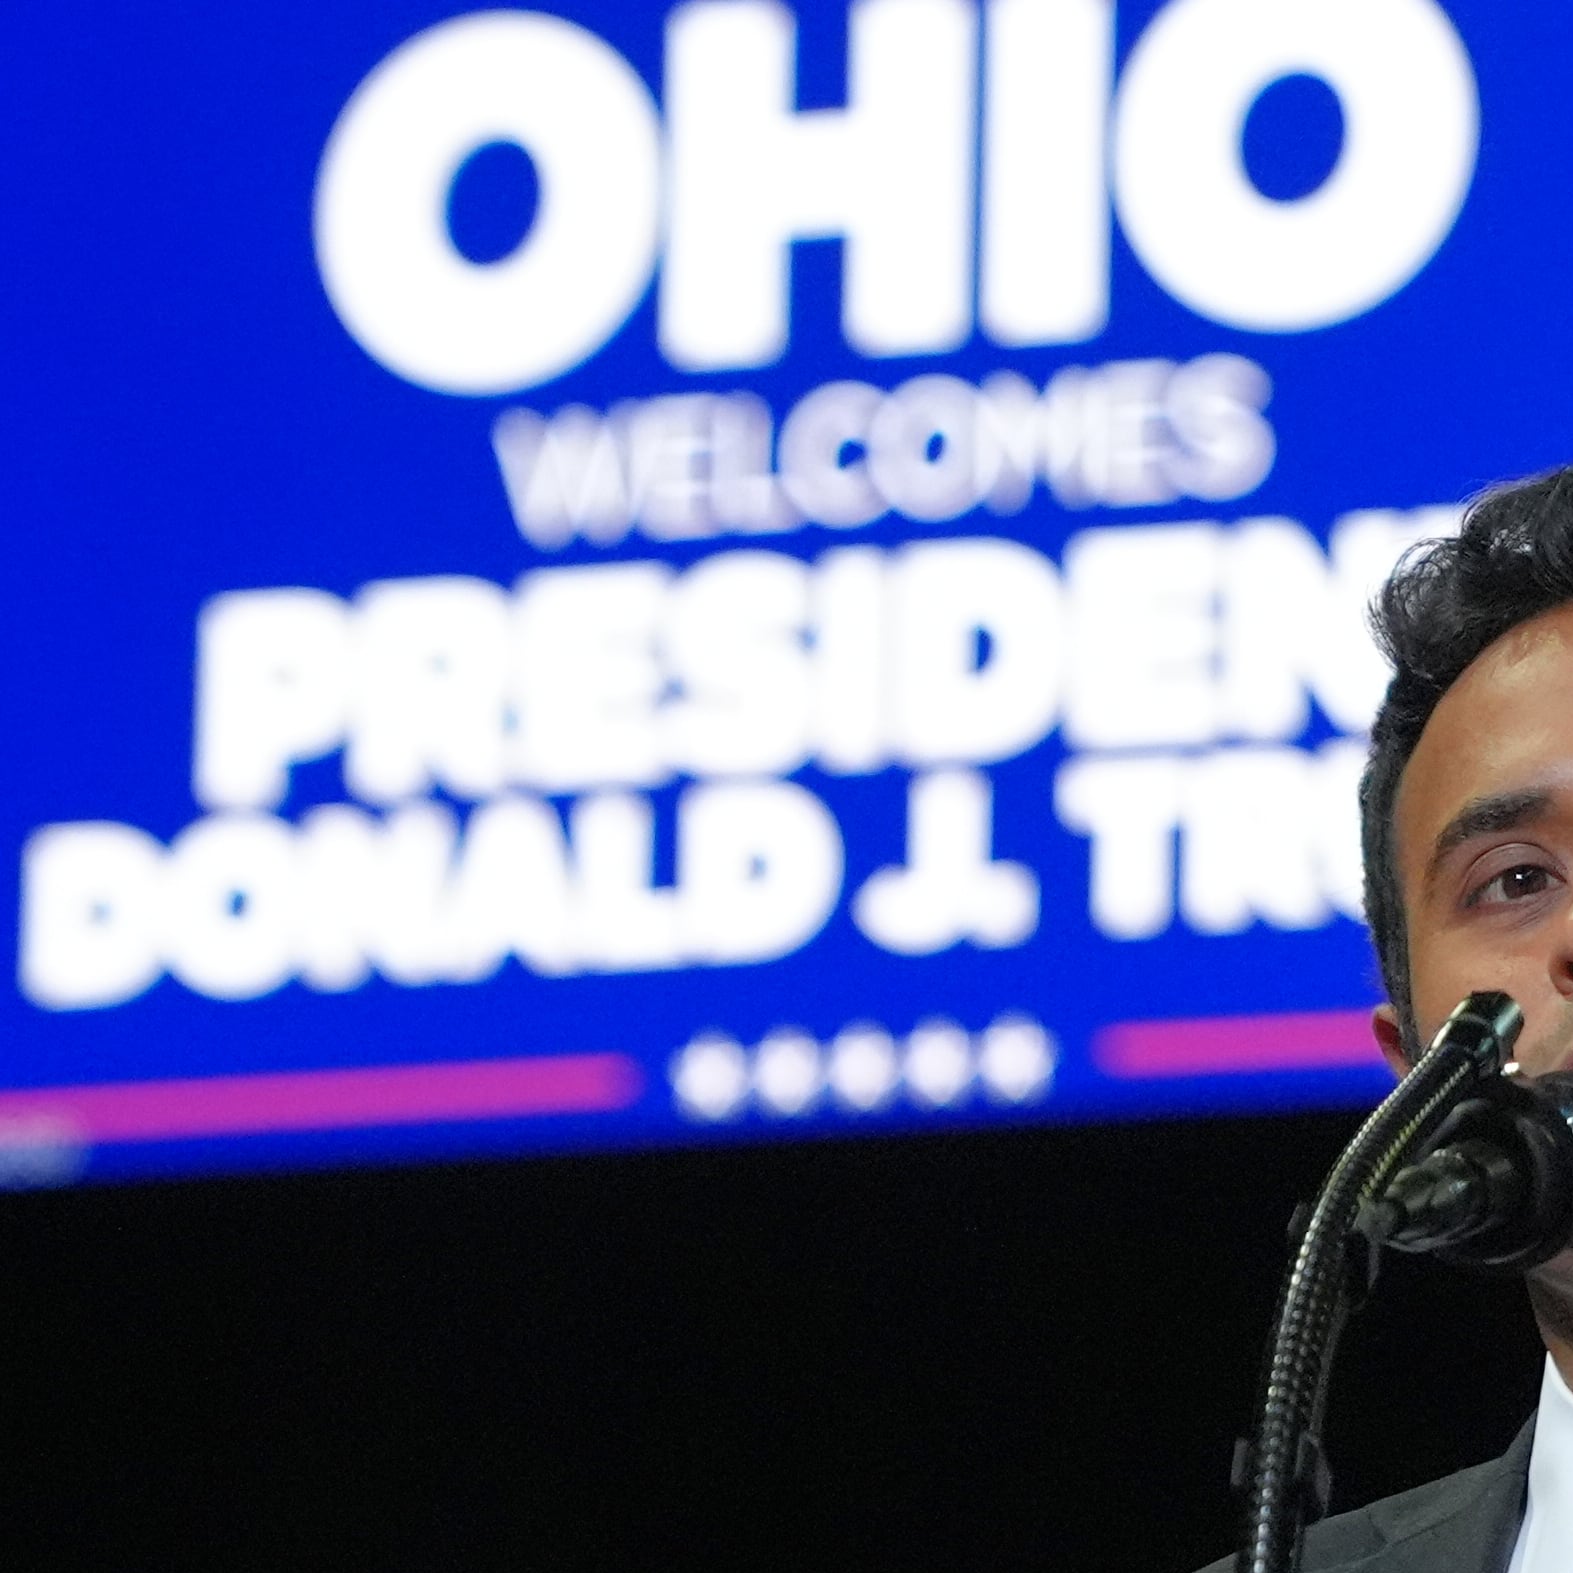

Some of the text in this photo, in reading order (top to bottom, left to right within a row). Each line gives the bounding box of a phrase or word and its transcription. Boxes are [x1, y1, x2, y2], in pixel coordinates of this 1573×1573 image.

[312, 0, 1482, 397] OHIO
[492, 352, 1277, 552] WELCOMES
[192, 500, 1460, 812] PRESIDEN
[18, 778, 845, 1012] DONALD
[852, 765, 1040, 956] J.
